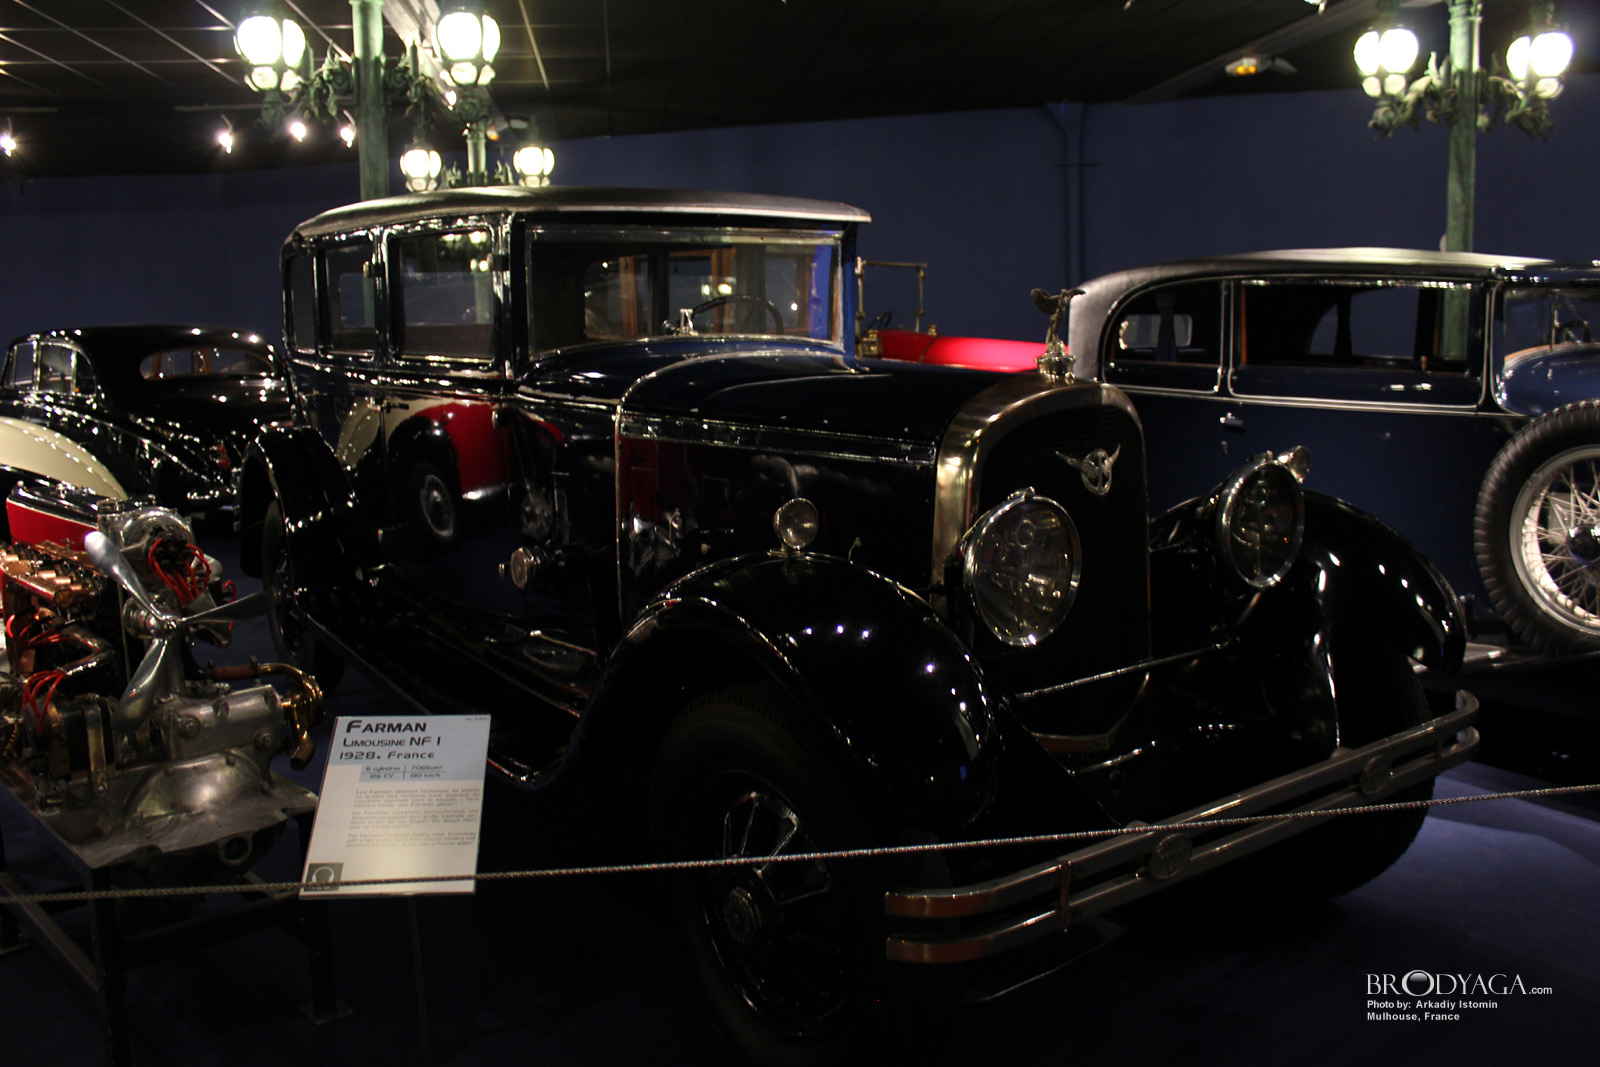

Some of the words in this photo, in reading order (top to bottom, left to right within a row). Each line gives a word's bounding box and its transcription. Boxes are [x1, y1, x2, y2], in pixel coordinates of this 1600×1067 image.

[346, 720, 427, 733] FARMAN
[343, 738, 406, 747] LIMOUSINE
[409, 736, 432, 746] NF
[340, 752, 381, 760] 1928.
[388, 751, 434, 760] France
